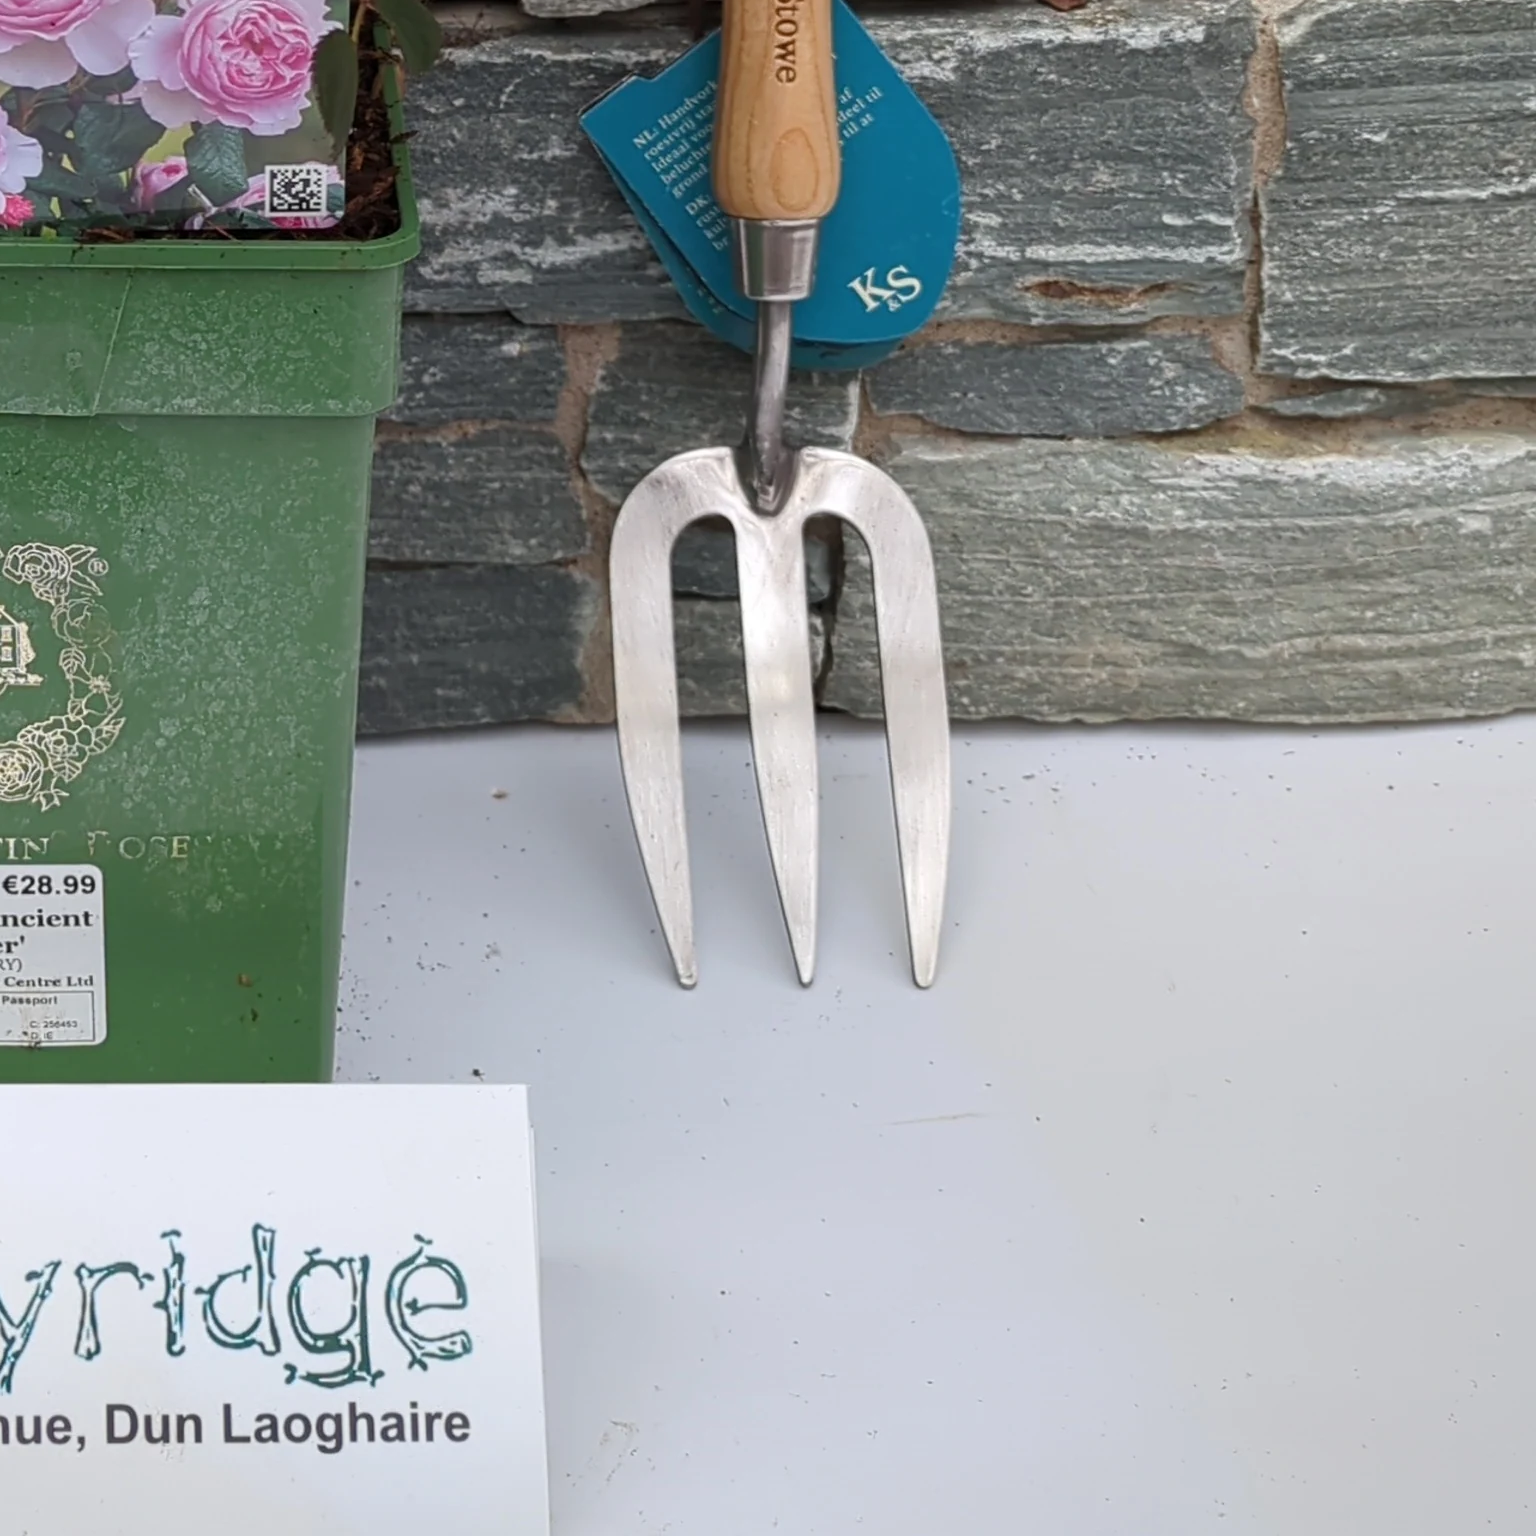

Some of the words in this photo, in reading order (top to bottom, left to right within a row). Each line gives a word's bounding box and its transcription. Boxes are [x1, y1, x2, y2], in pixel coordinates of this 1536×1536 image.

[836, 98, 866, 126] deel
[651, 140, 690, 173] Ideaal
[2, 874, 96, 895] €28.99
[3, 976, 62, 987] Centre
[66, 975, 94, 987] Ltd
[2, 995, 59, 1007] Passport
[105, 1403, 204, 1445] Dun
[223, 1401, 471, 1455] Laoghaire
